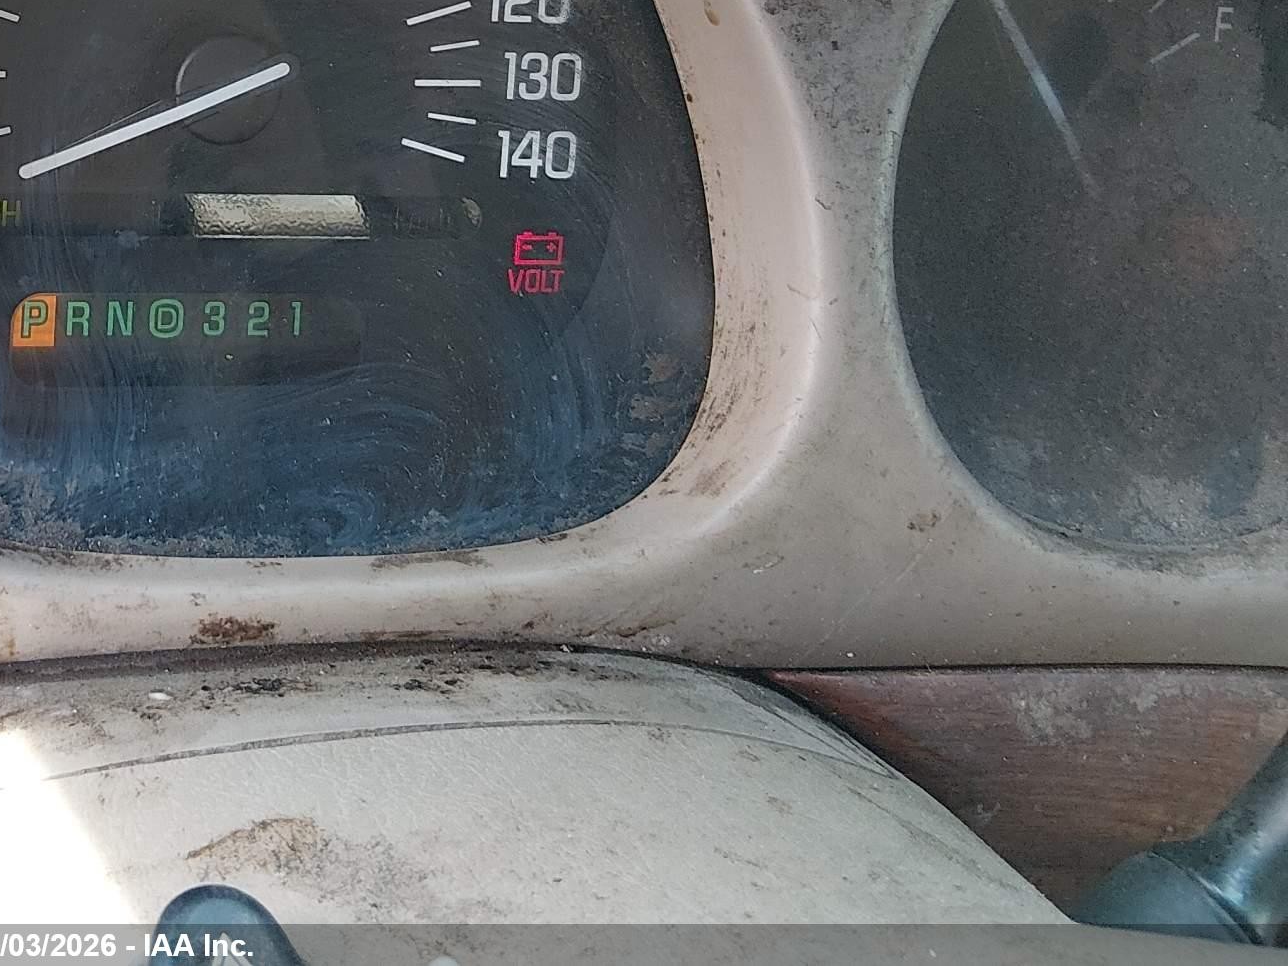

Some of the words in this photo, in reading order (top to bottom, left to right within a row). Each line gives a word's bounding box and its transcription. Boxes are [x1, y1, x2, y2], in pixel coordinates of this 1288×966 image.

[1215, 7, 1235, 42] F
[504, 52, 582, 101] 130
[498, 130, 577, 178] 140
[508, 269, 565, 293] VOLT
[20, 298, 49, 338] P
[66, 301, 91, 336] R
[107, 301, 134, 336] N
[203, 301, 226, 336] 3
[247, 301, 270, 337] 2
[291, 301, 302, 336] 1
